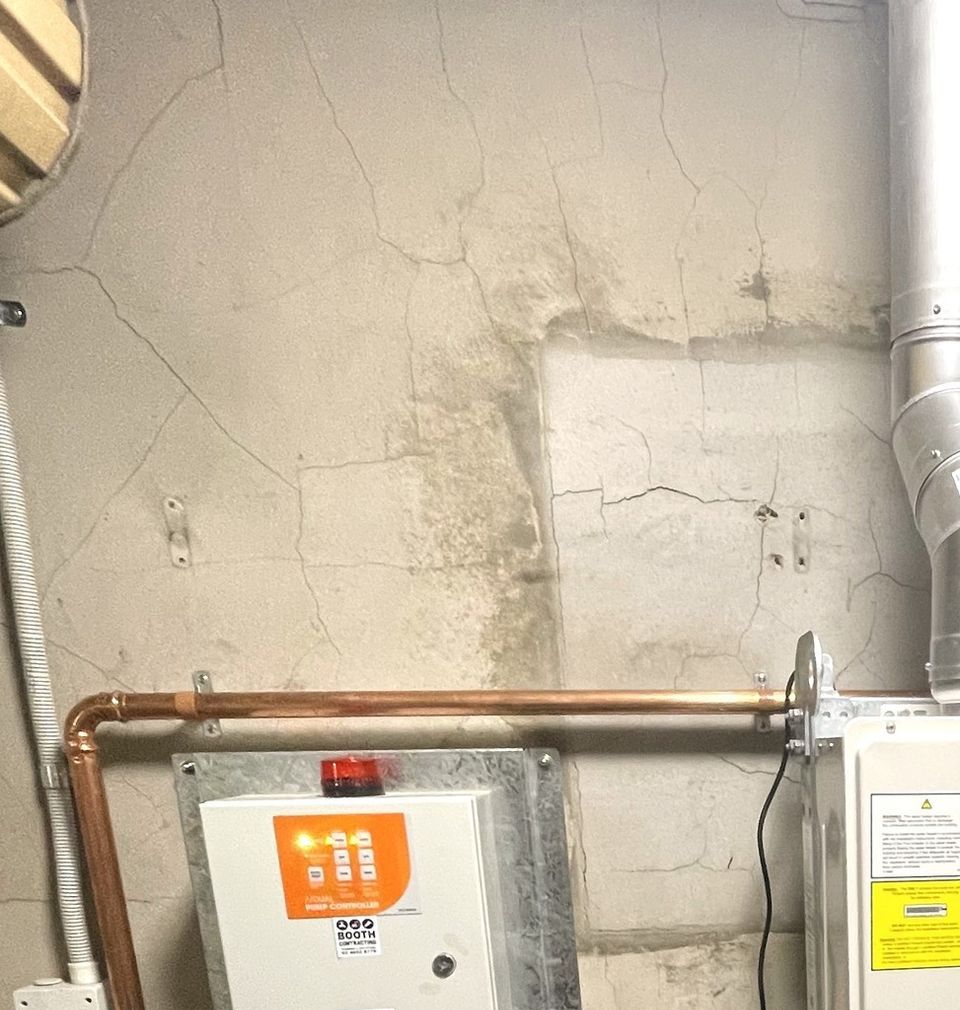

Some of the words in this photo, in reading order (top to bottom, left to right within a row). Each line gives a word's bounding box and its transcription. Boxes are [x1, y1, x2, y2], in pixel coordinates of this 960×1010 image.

[305, 902, 328, 912] PUMP
[329, 901, 379, 910] CONTROLLER
[337, 930, 376, 940] BOOTH
